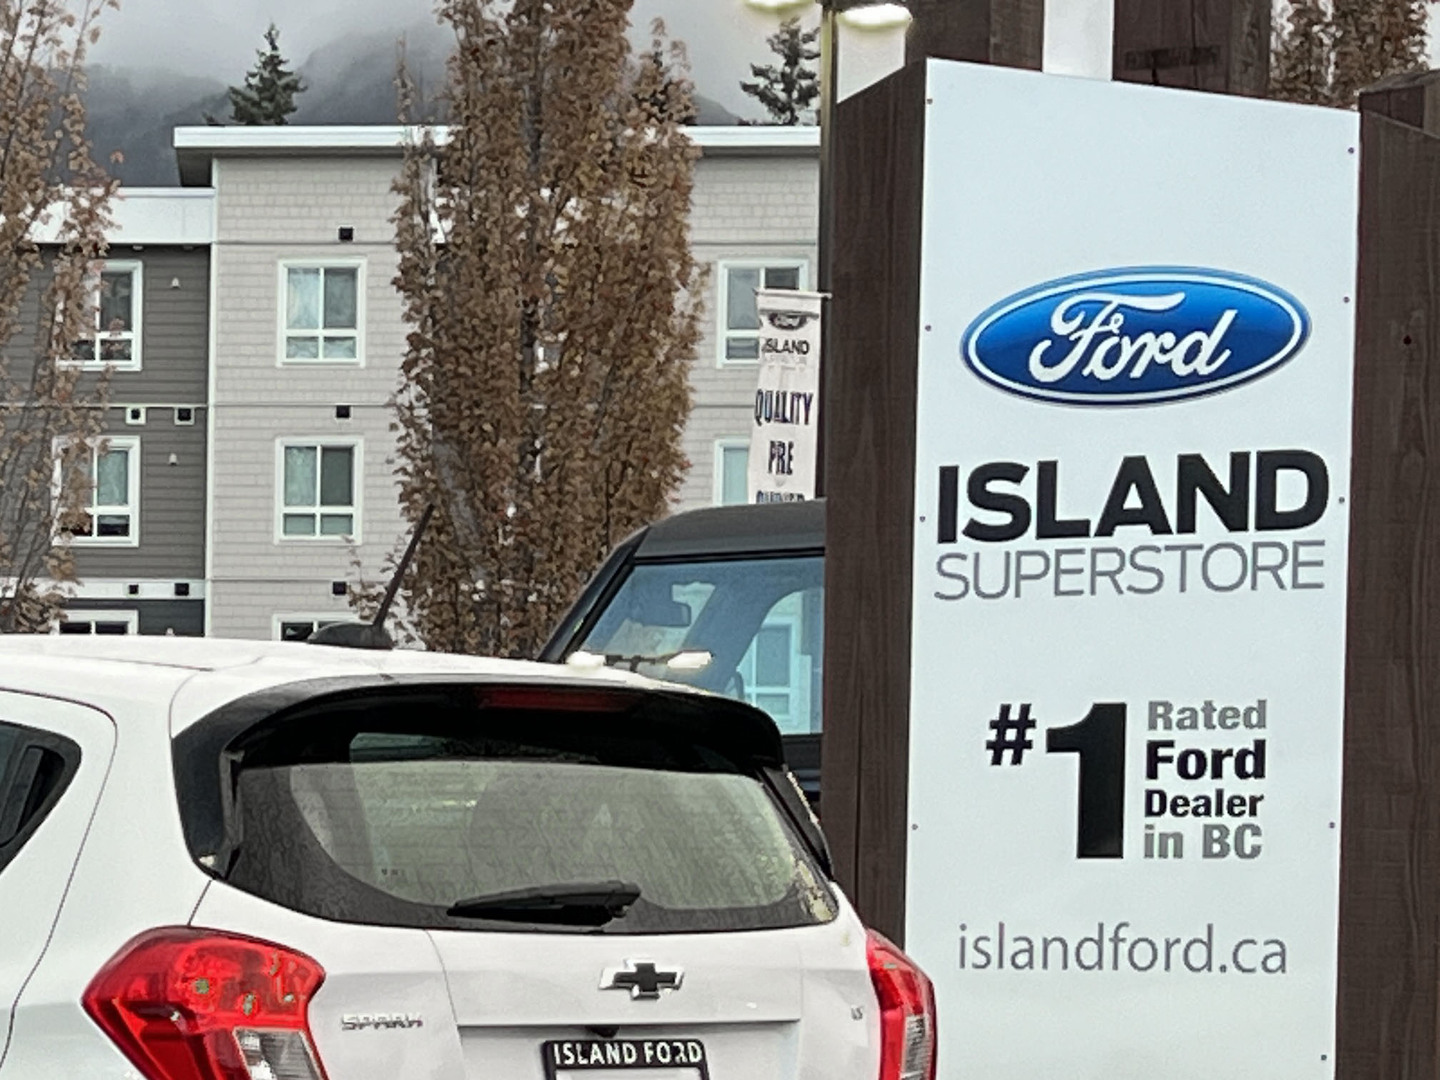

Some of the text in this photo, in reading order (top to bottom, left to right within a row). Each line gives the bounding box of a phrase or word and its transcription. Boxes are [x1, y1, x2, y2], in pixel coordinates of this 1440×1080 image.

[1028, 291, 1239, 383] Ford
[755, 388, 813, 426] QUALITY
[768, 440, 795, 475] PRE
[937, 449, 1330, 544] ISLAND
[934, 540, 1326, 601] SUPERSTORE
[1146, 699, 1268, 732] Rated
[1145, 739, 1267, 781] Ford
[1144, 789, 1265, 818] Dealer
[1143, 823, 1263, 859] in BC
[958, 921, 1288, 975] islandford.ca
[341, 1012, 424, 1031] SPARK
[553, 1041, 703, 1065] ISLAND FORD
